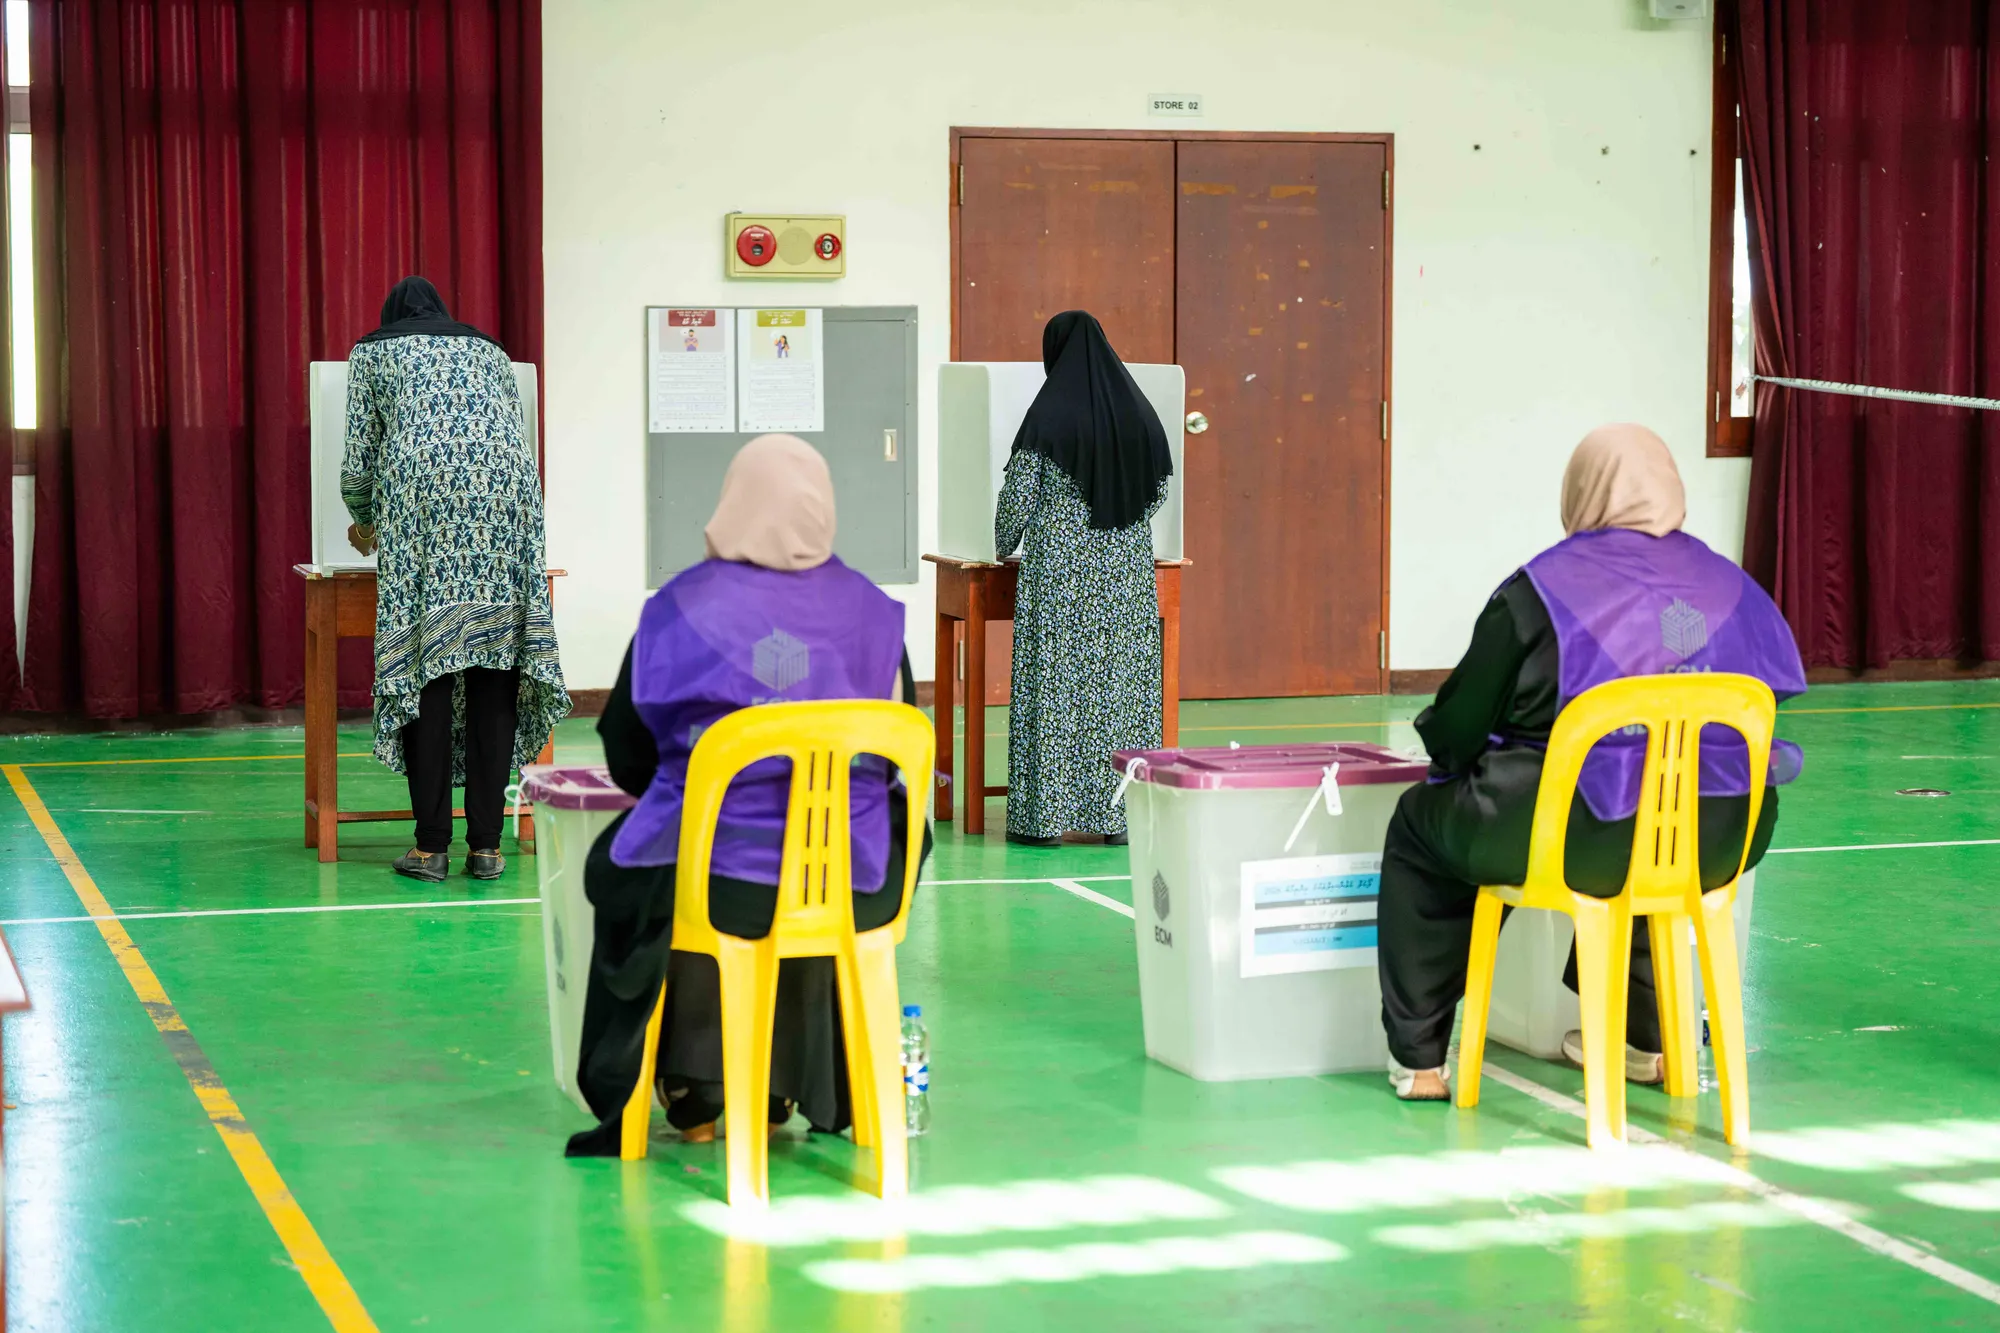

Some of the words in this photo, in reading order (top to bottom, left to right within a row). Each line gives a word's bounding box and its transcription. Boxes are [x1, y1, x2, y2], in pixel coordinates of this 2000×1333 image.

[1154, 101, 1184, 110] STORE
[1188, 101, 1198, 110] 02
[1154, 925, 1173, 948] ECM
